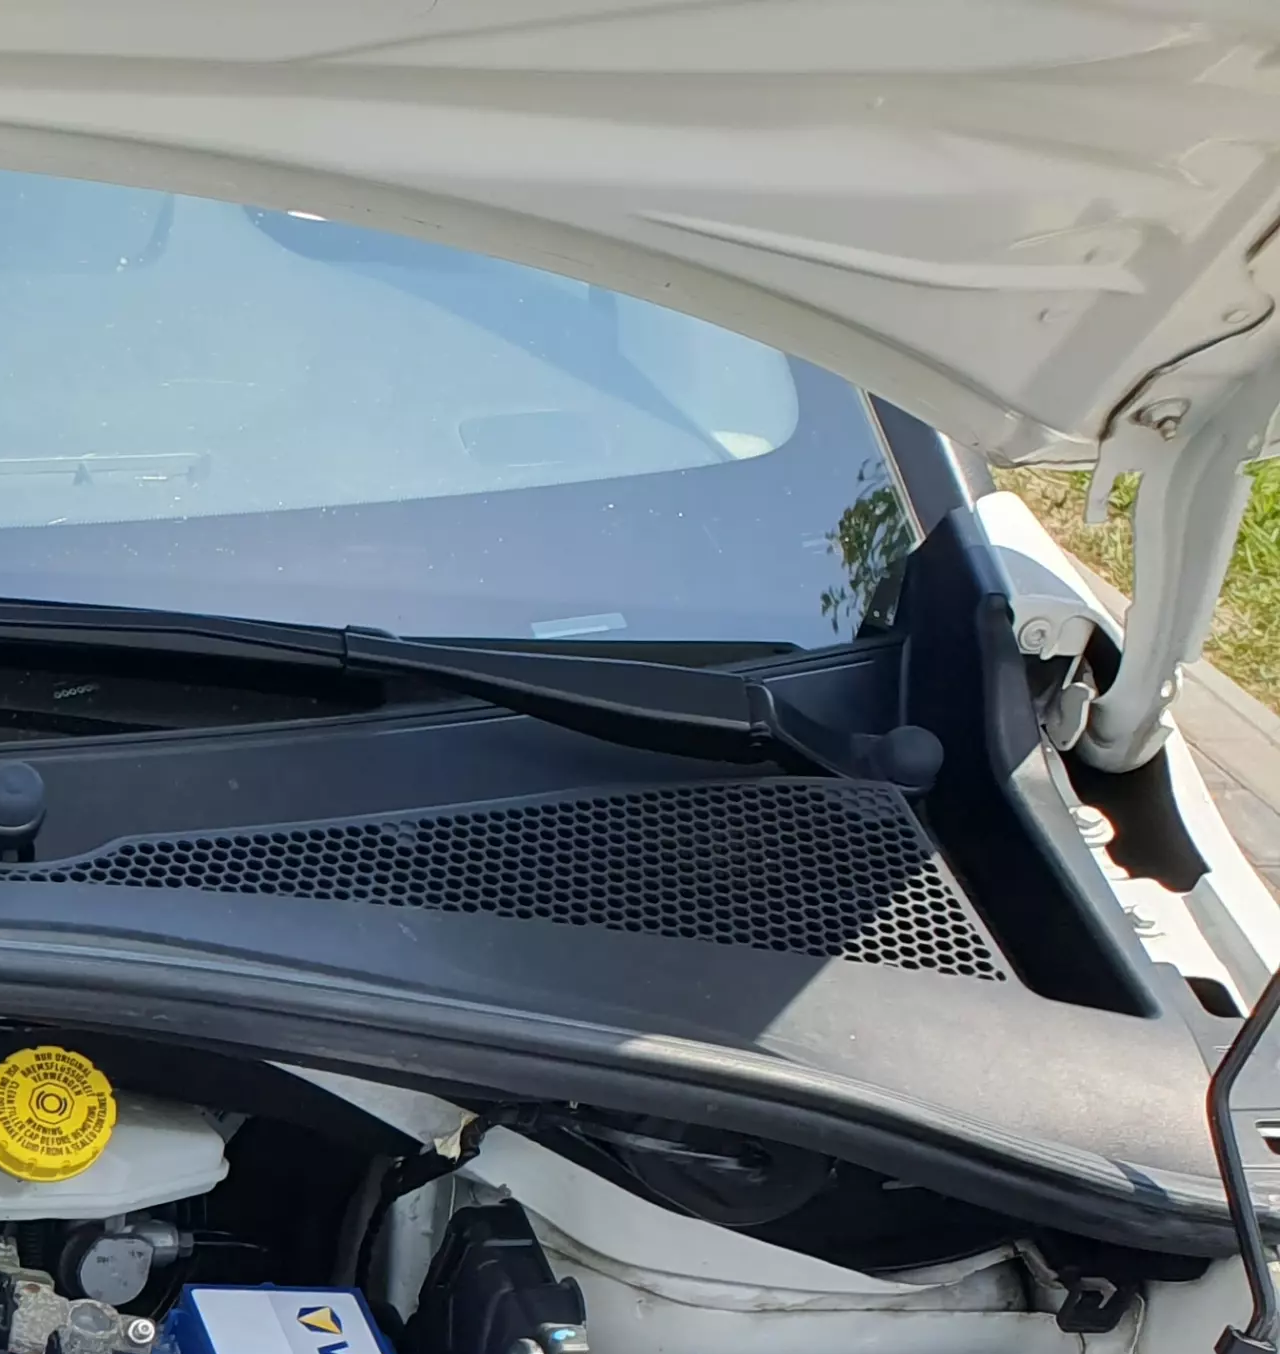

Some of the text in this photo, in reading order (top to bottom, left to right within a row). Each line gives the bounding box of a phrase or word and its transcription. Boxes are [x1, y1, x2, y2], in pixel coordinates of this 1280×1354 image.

[34, 1052, 92, 1077] NUR ORIGINAL
[31, 1072, 82, 1096] VERWENDEN
[4, 1064, 20, 1077] USE
[16, 1138, 40, 1152] FLUID
[40, 1146, 64, 1156] FROM
[72, 1130, 97, 1152] SEALED
[95, 1092, 108, 1130] CONTAINER
[6, 1081, 97, 1146] CLEAN FILLER CAP BEFORE REMOVING
[25, 1117, 63, 1135] WARNING
